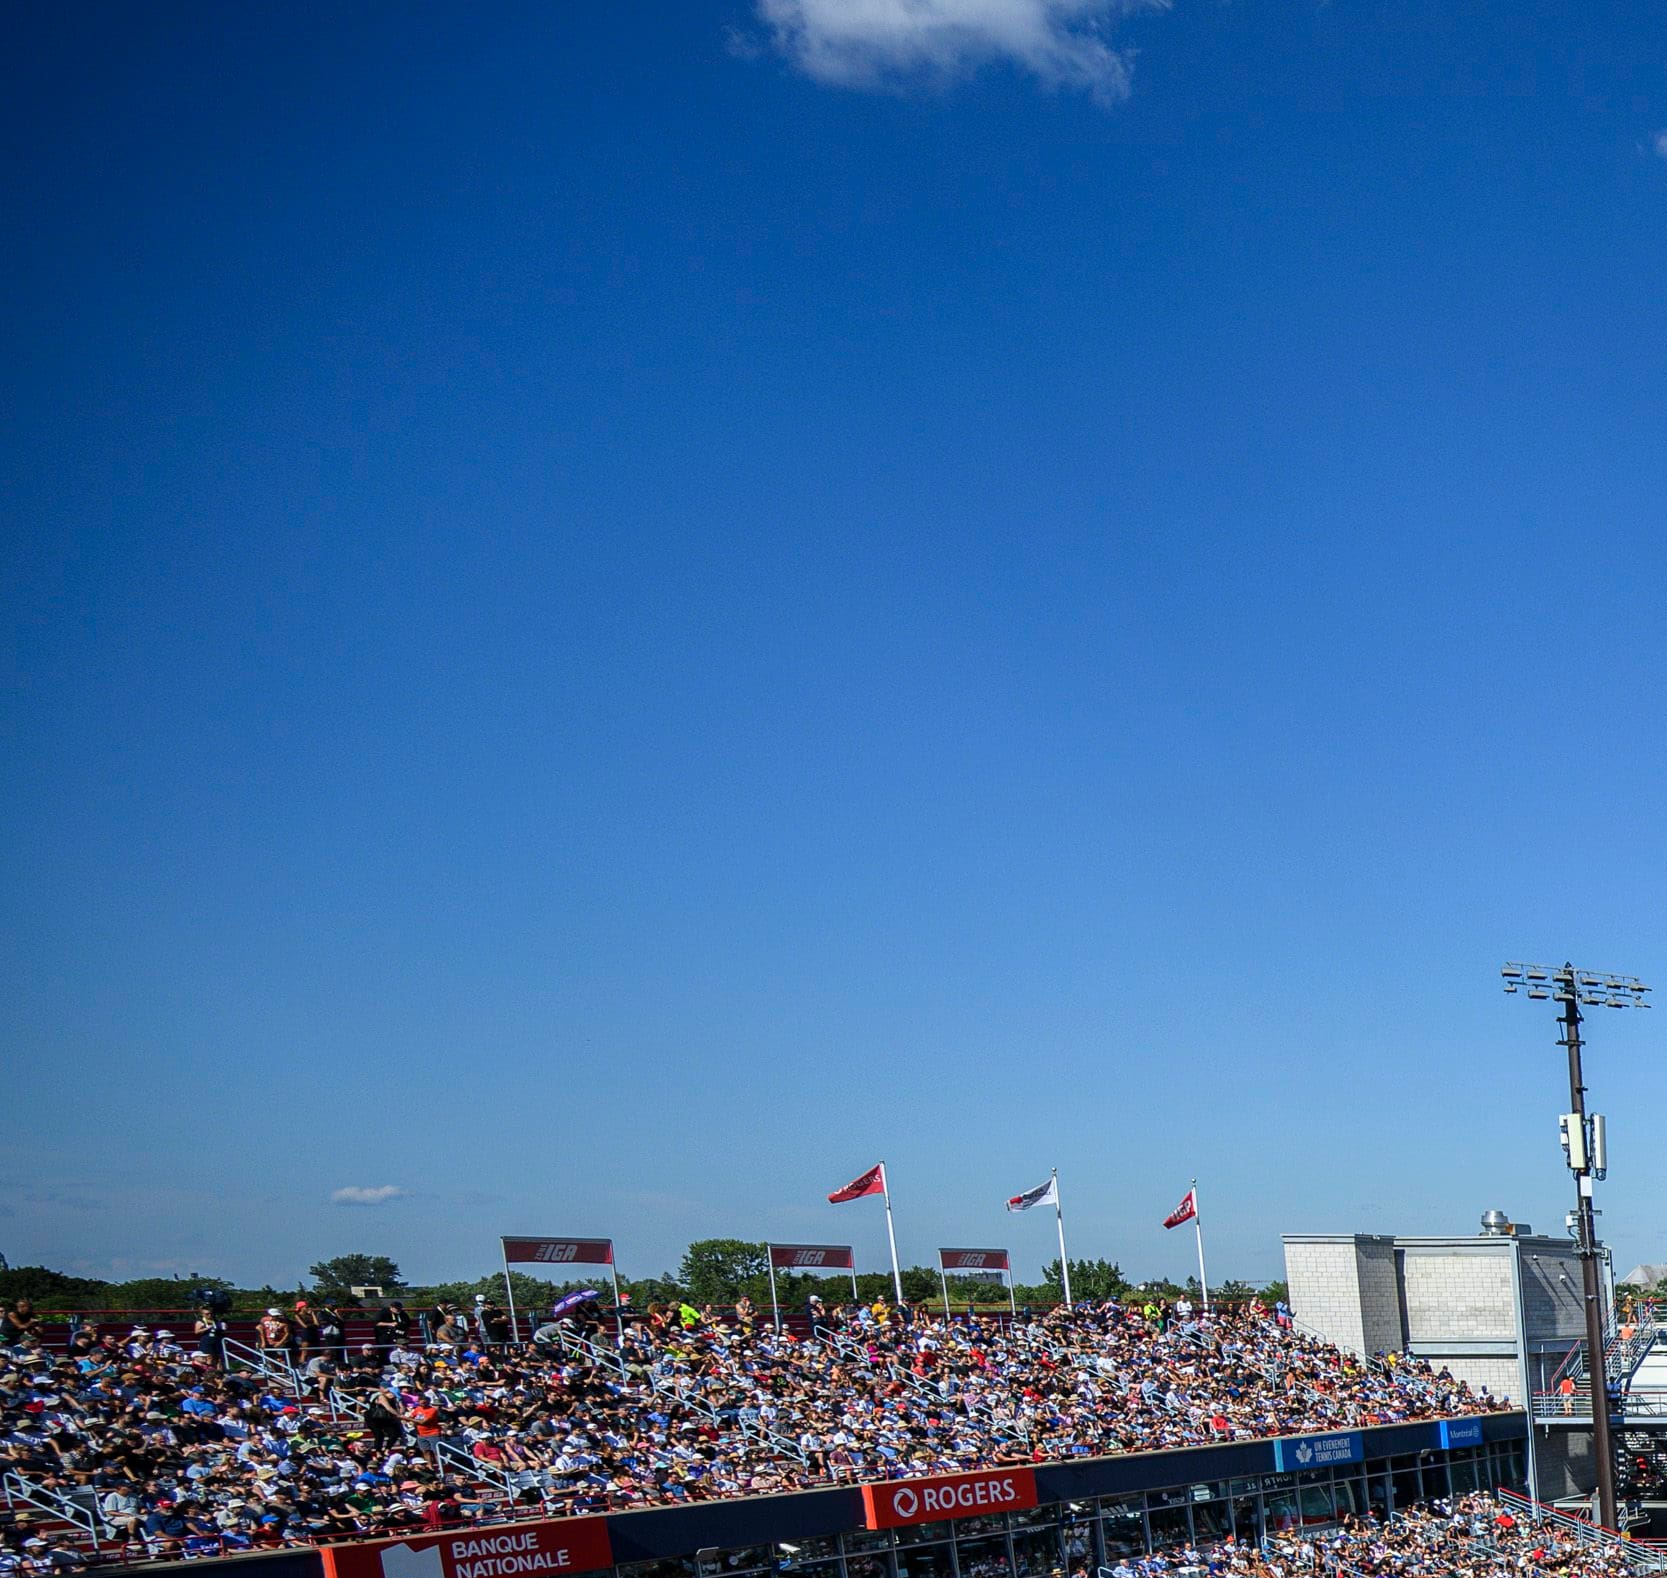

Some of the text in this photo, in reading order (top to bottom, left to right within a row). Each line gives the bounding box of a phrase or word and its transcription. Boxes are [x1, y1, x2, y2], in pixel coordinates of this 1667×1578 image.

[543, 1244, 578, 1261] IGA
[798, 1250, 826, 1265] IGA
[963, 1253, 986, 1266] IGA
[1315, 1447, 1352, 1462] TENNIS CANADA
[922, 1478, 1016, 1511] ROGERS
[451, 1532, 539, 1559] BANQUE
